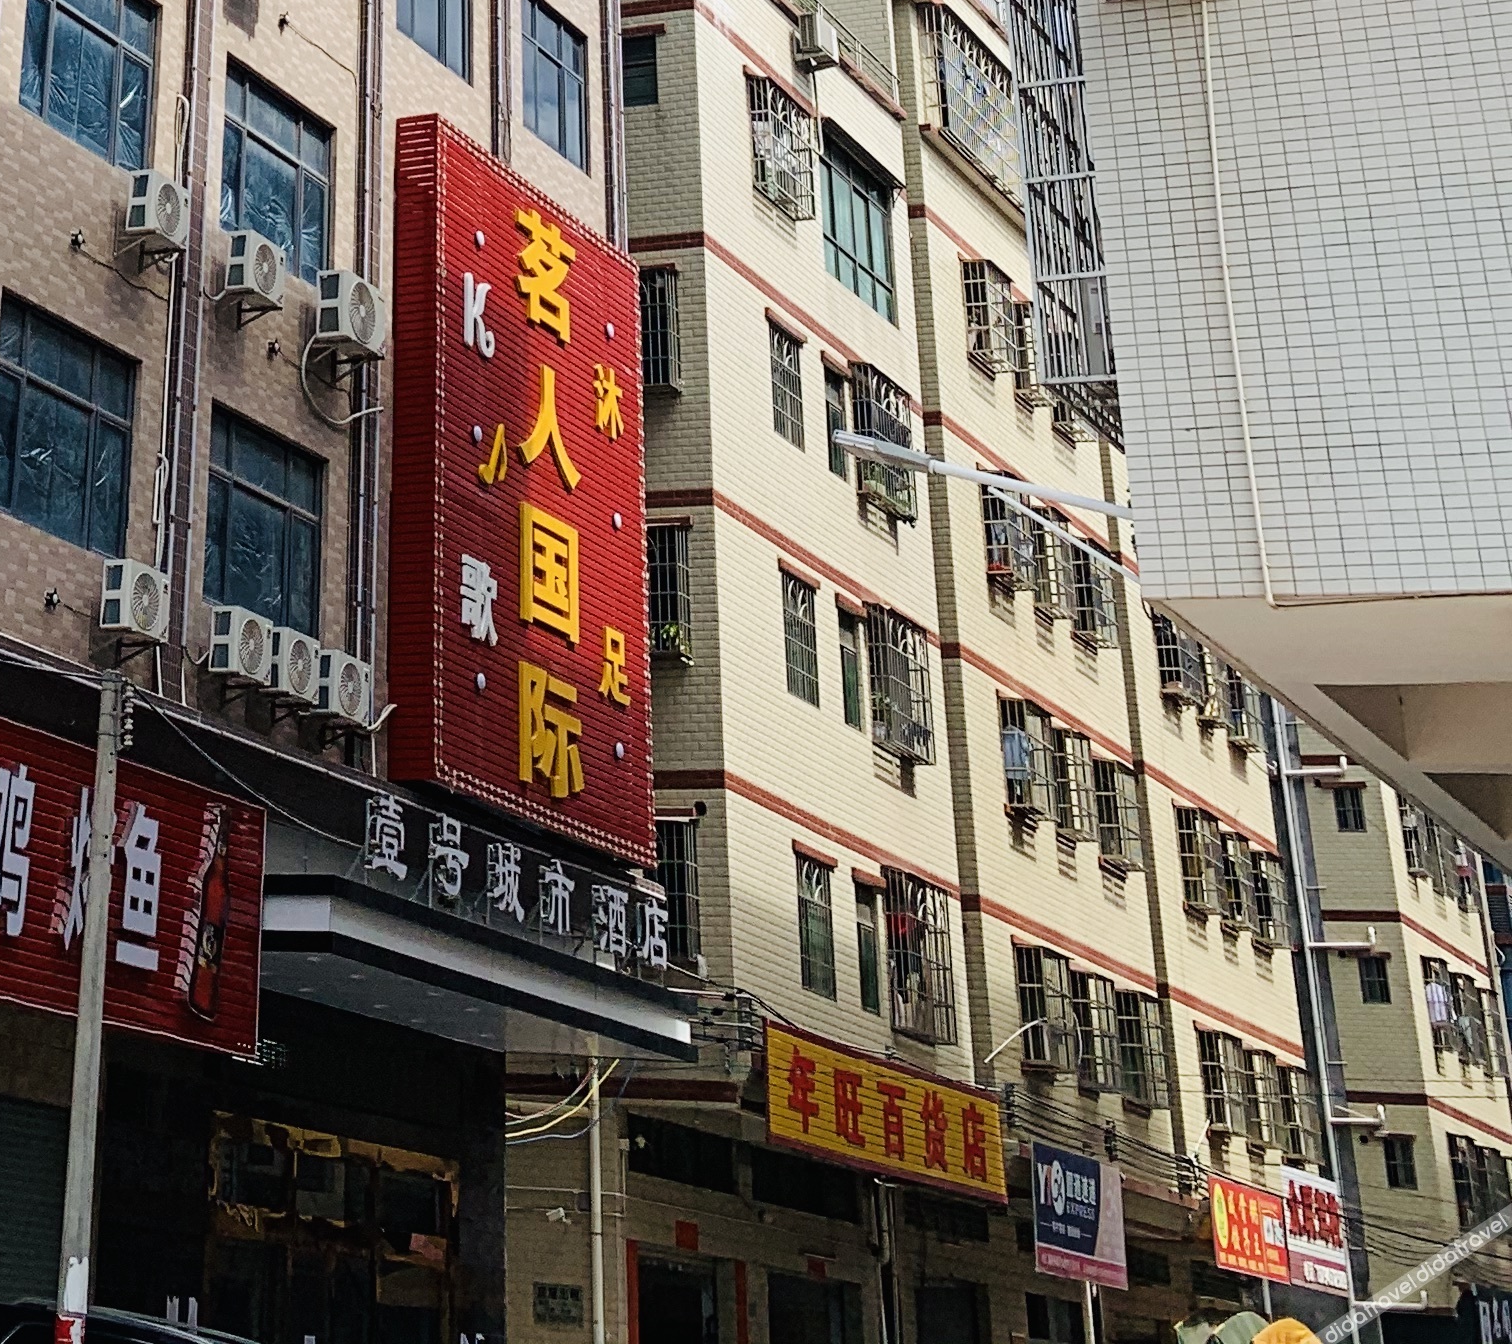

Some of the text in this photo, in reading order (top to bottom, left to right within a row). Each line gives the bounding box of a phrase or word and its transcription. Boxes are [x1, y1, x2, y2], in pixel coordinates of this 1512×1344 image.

[515, 207, 586, 799] 茗人国际
[593, 362, 632, 707] 沐足
[364, 794, 669, 972] 壹号城市酒店
